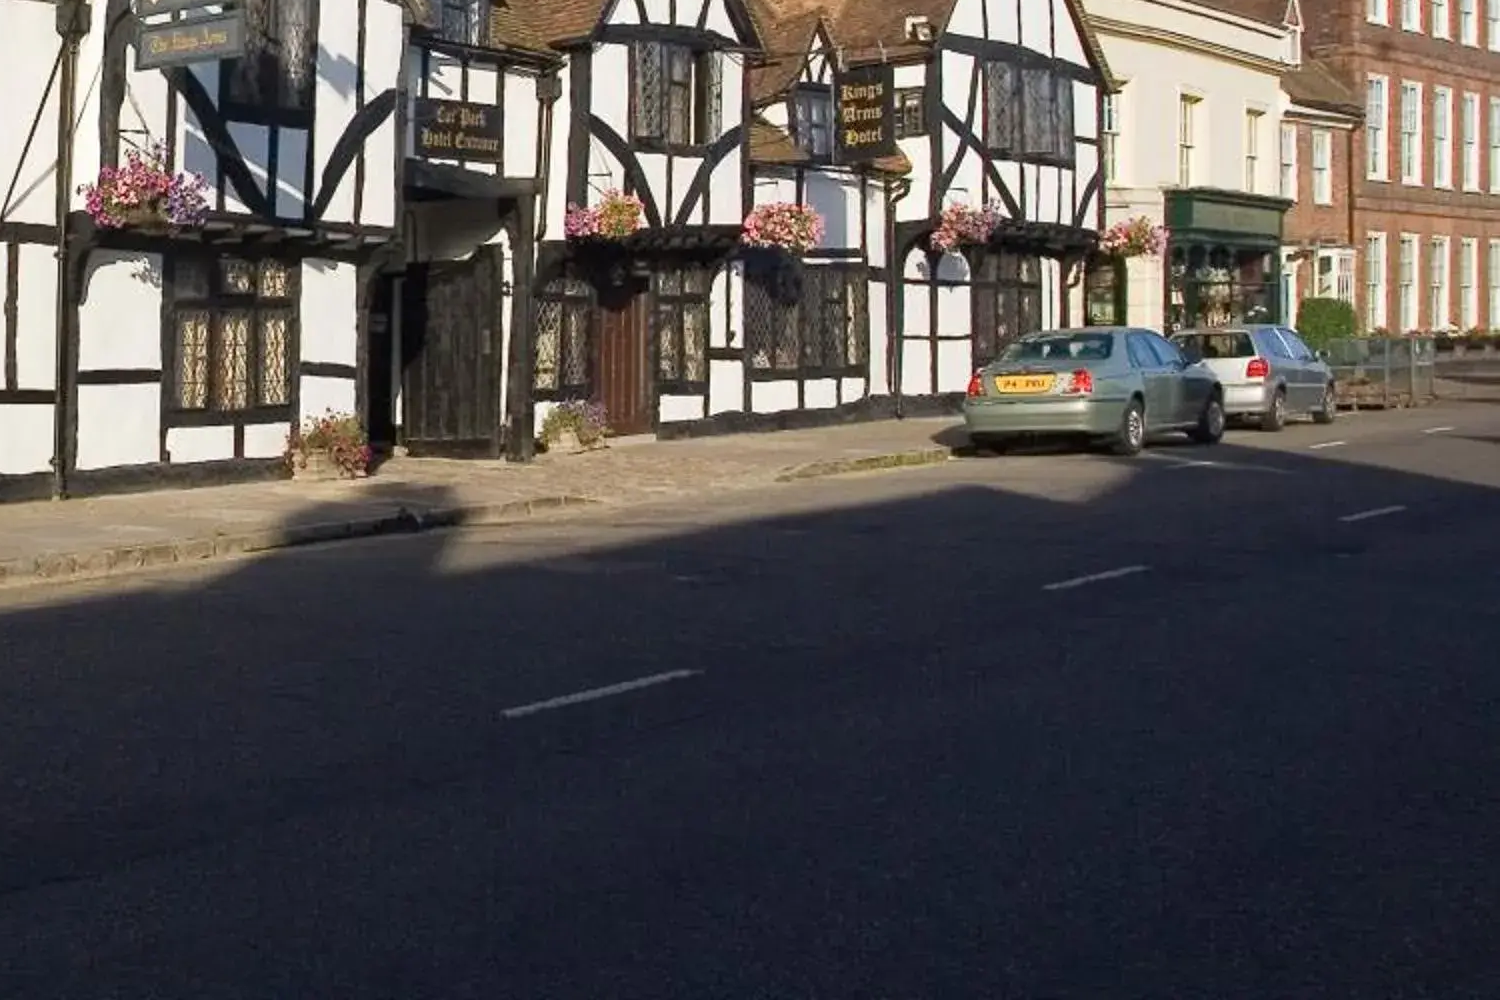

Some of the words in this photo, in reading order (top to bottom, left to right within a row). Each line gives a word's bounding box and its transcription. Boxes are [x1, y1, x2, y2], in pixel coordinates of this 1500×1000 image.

[840, 83, 883, 101] Kings
[843, 106, 883, 123] Arms
[845, 127, 883, 145] Hotel
